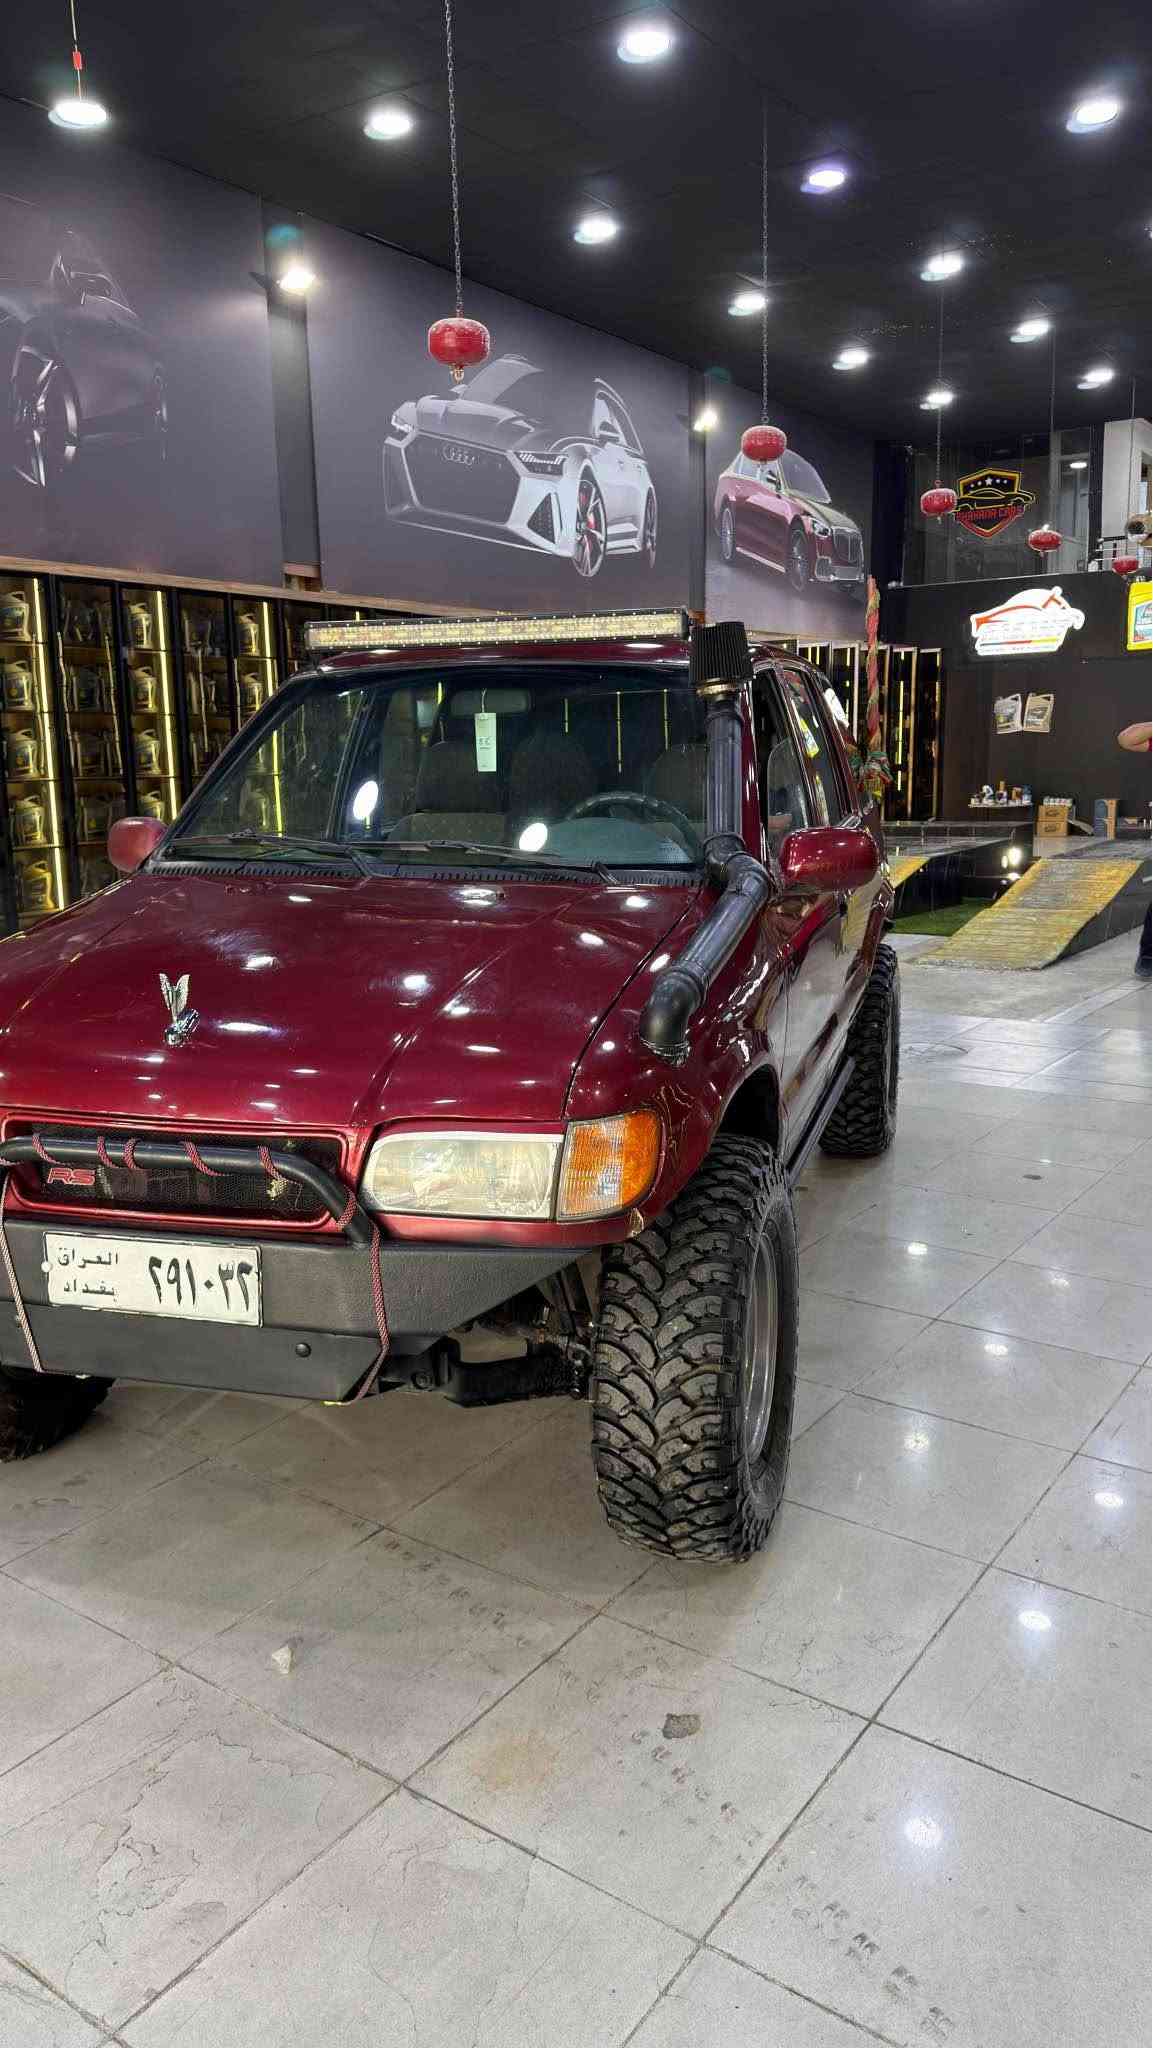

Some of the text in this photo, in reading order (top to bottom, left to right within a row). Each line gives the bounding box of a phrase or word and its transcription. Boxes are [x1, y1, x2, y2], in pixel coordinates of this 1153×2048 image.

[47, 1167, 95, 1186] RS
[57, 1248, 119, 1269] العراق
[63, 1279, 118, 1302] بغداد
